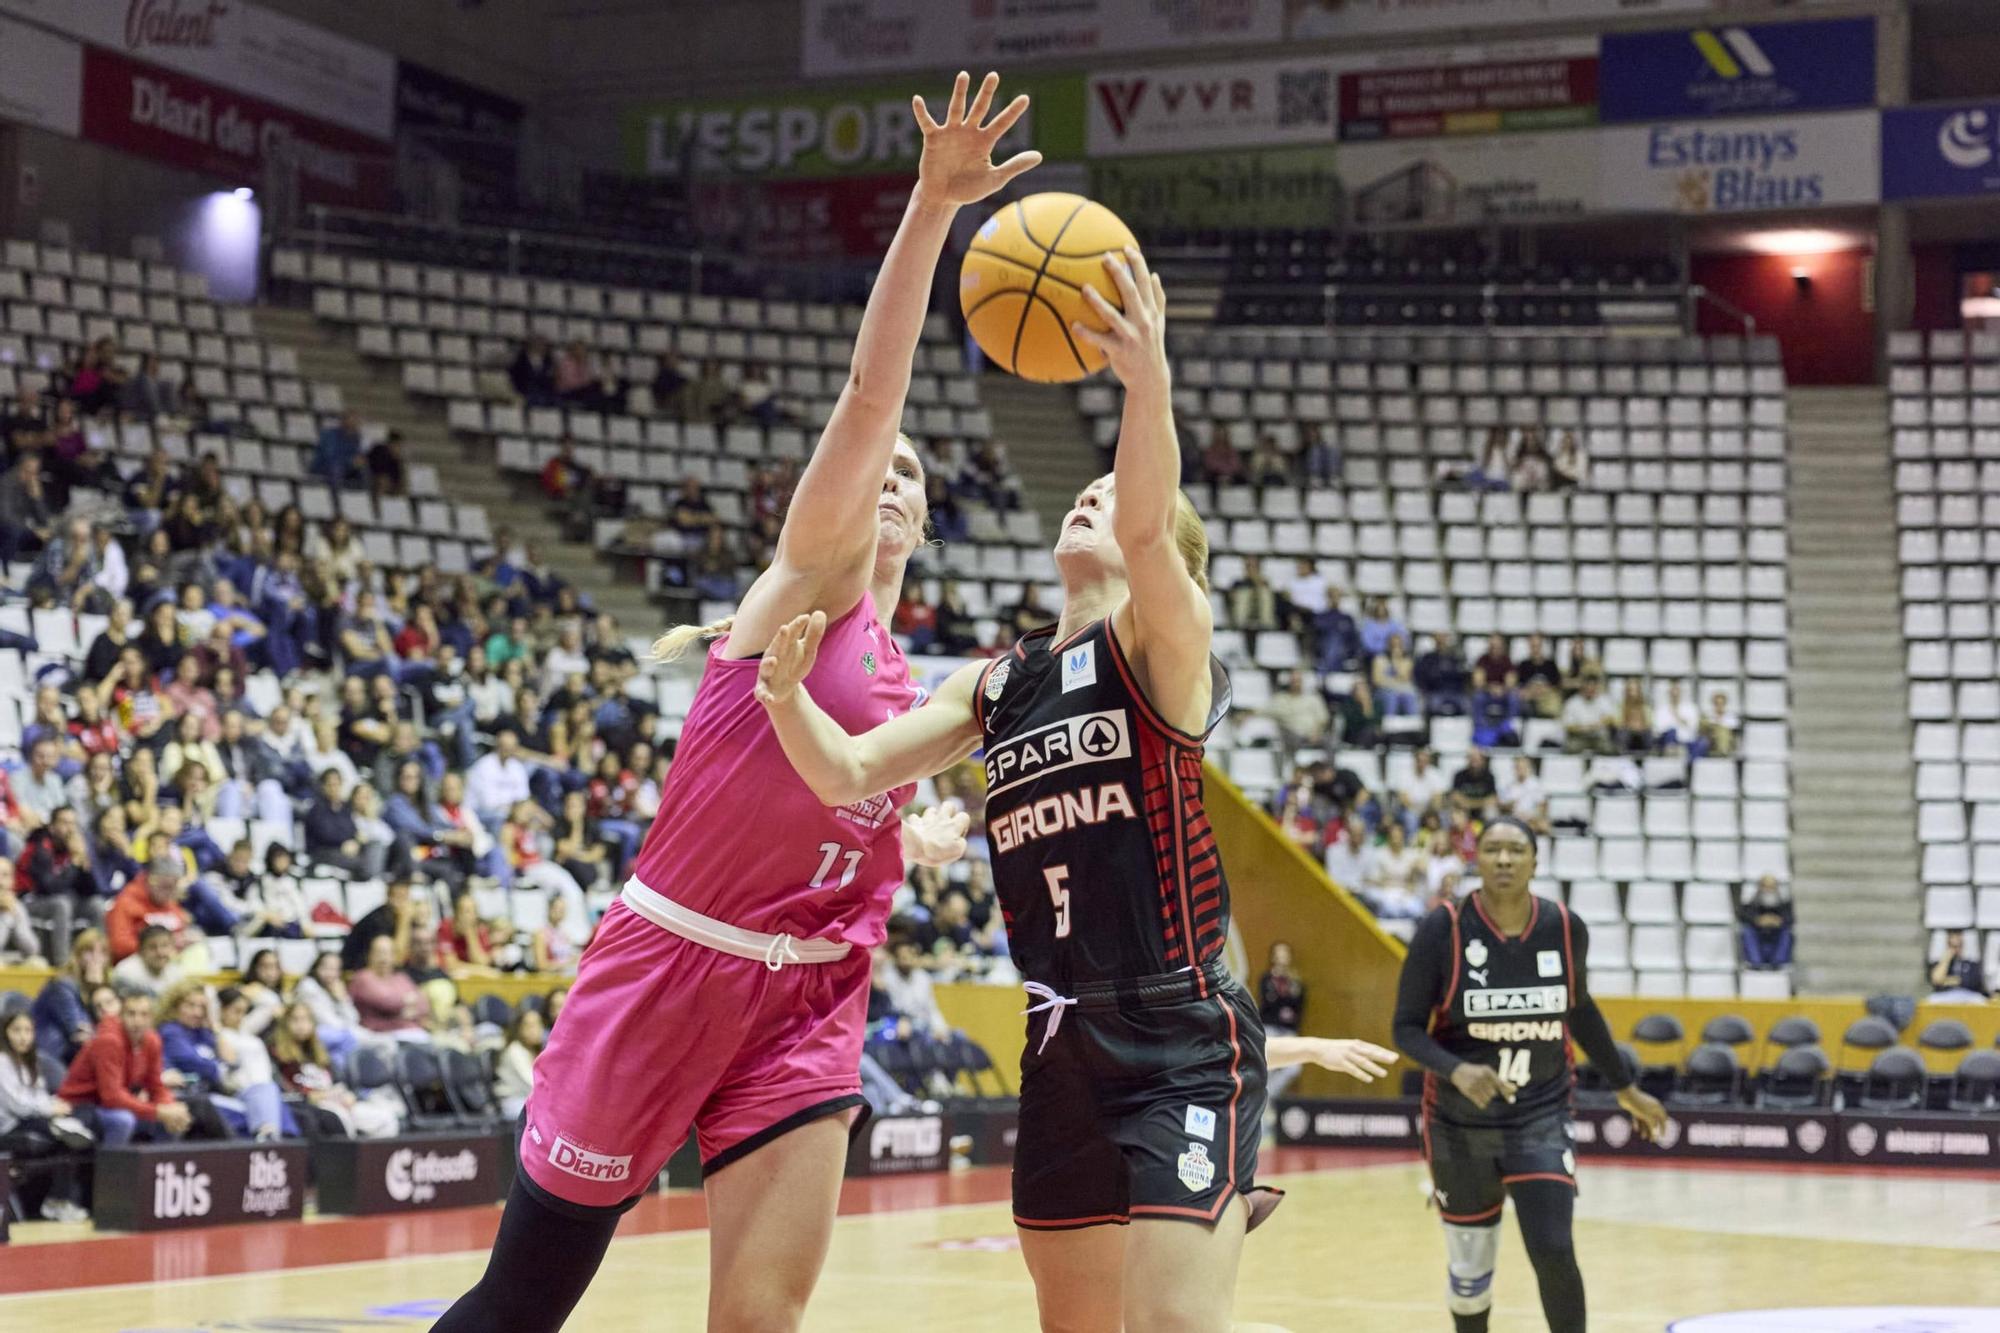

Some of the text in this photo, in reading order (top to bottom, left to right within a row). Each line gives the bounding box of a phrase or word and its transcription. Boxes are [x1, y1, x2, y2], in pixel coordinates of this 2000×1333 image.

[131, 77, 211, 144] Diari
[215, 105, 255, 155] de
[646, 100, 1031, 174] L'ESPOR
[1648, 127, 1798, 170] Estanys
[1714, 168, 1823, 206] Blaus
[987, 731, 1070, 788] SPAR
[990, 782, 1137, 853] GIRONA
[808, 841, 865, 892] 11
[1043, 864, 1070, 938] 5
[1471, 992, 1543, 1011] SPAR
[1468, 1020, 1563, 1042] GIRONA
[1498, 1048, 1531, 1087] 14
[249, 1151, 287, 1188] ibis
[555, 1143, 625, 1179] Diario
[155, 1162, 211, 1218] ibis
